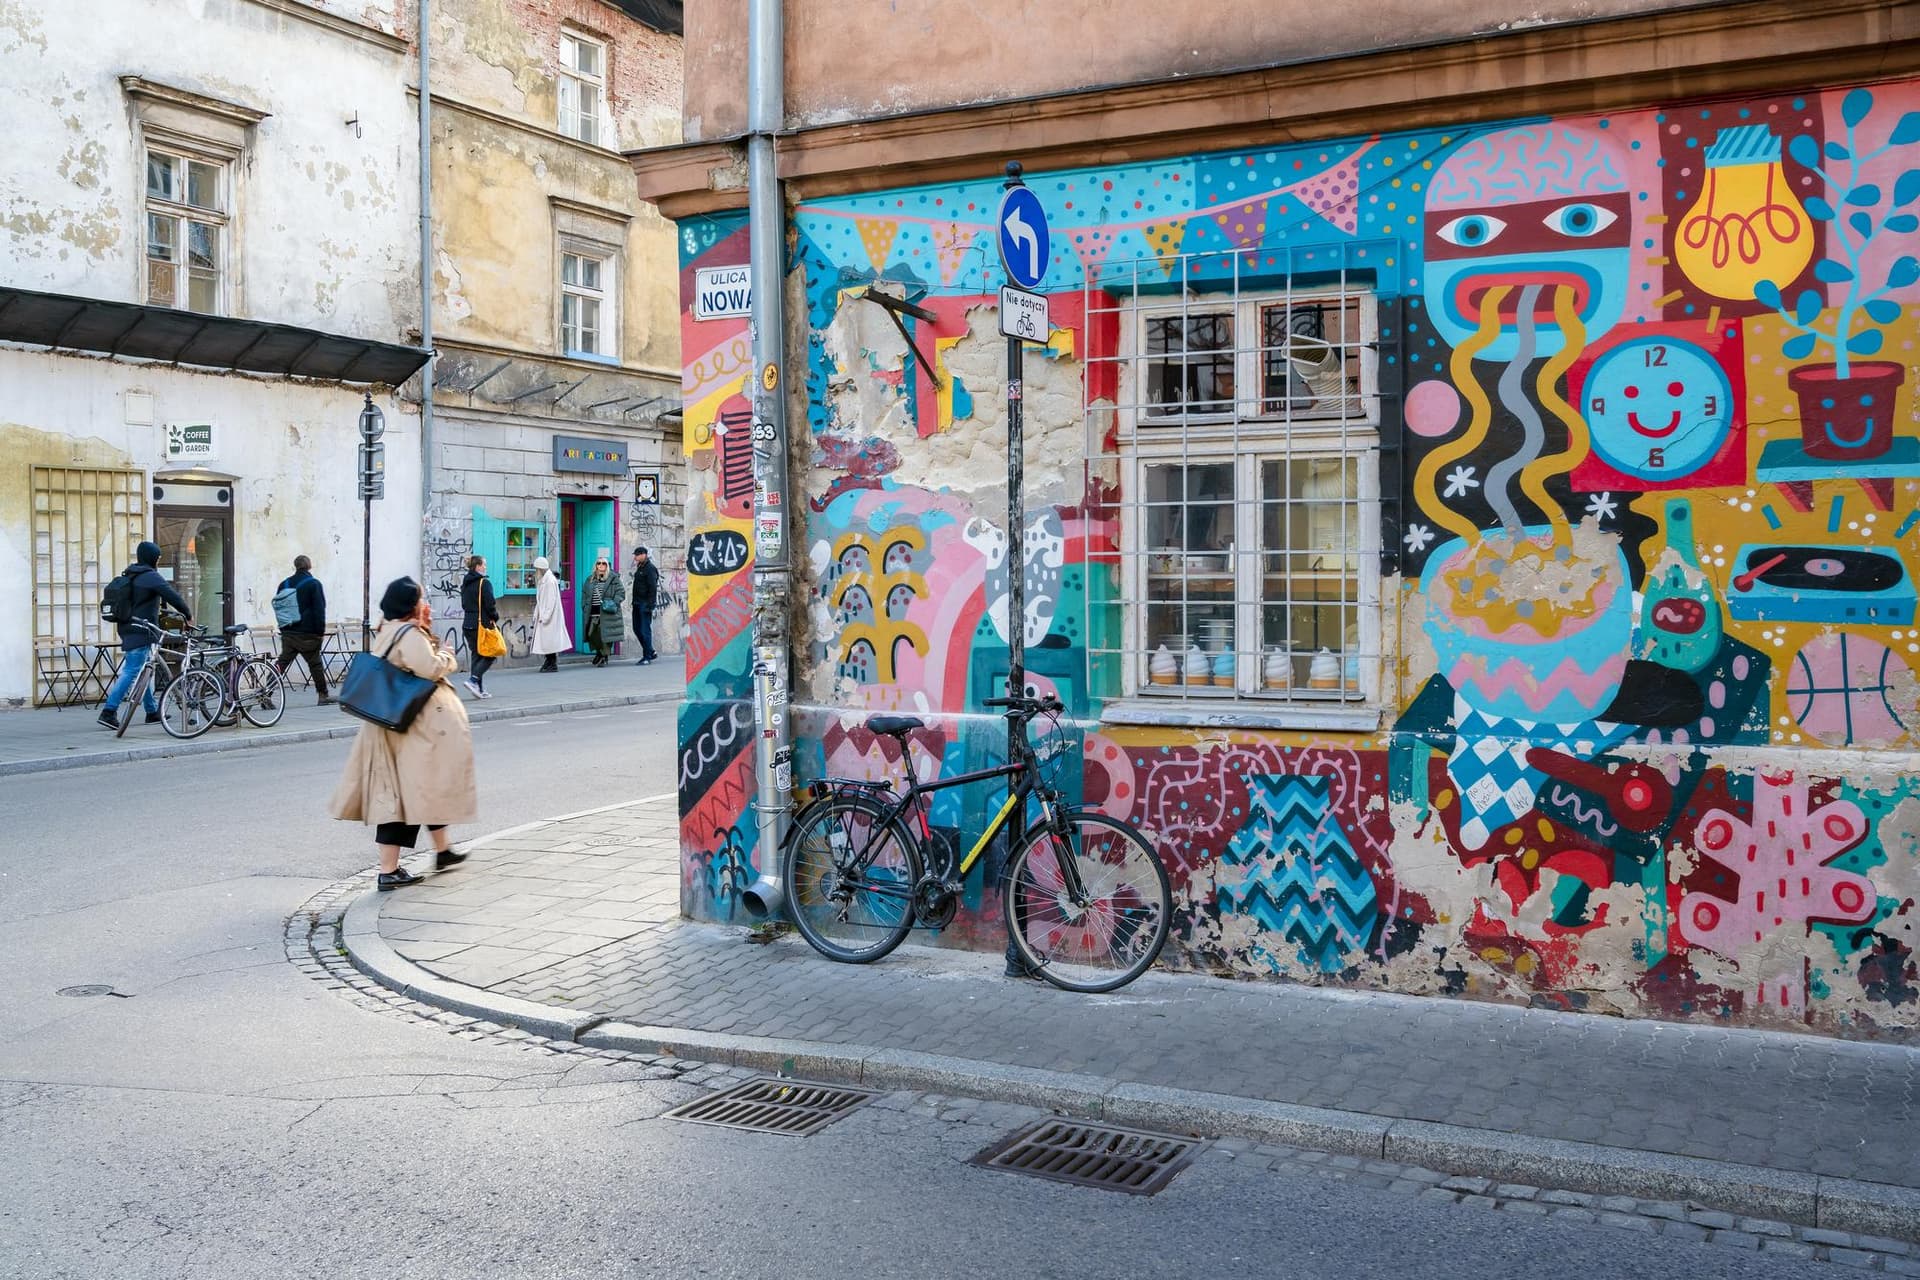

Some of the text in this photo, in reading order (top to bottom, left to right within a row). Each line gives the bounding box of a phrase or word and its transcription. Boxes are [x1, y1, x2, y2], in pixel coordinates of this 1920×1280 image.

[711, 272, 747, 285] ULICA
[1006, 291, 1045, 315] Nie dotyczy
[1645, 346, 1667, 368] 12
[1704, 396, 1716, 416] 3
[185, 431, 209, 439] COFFEE
[185, 444, 210, 452] GARDEN
[563, 448, 623, 462] ART FACTORY
[1649, 447, 1664, 467] 6
